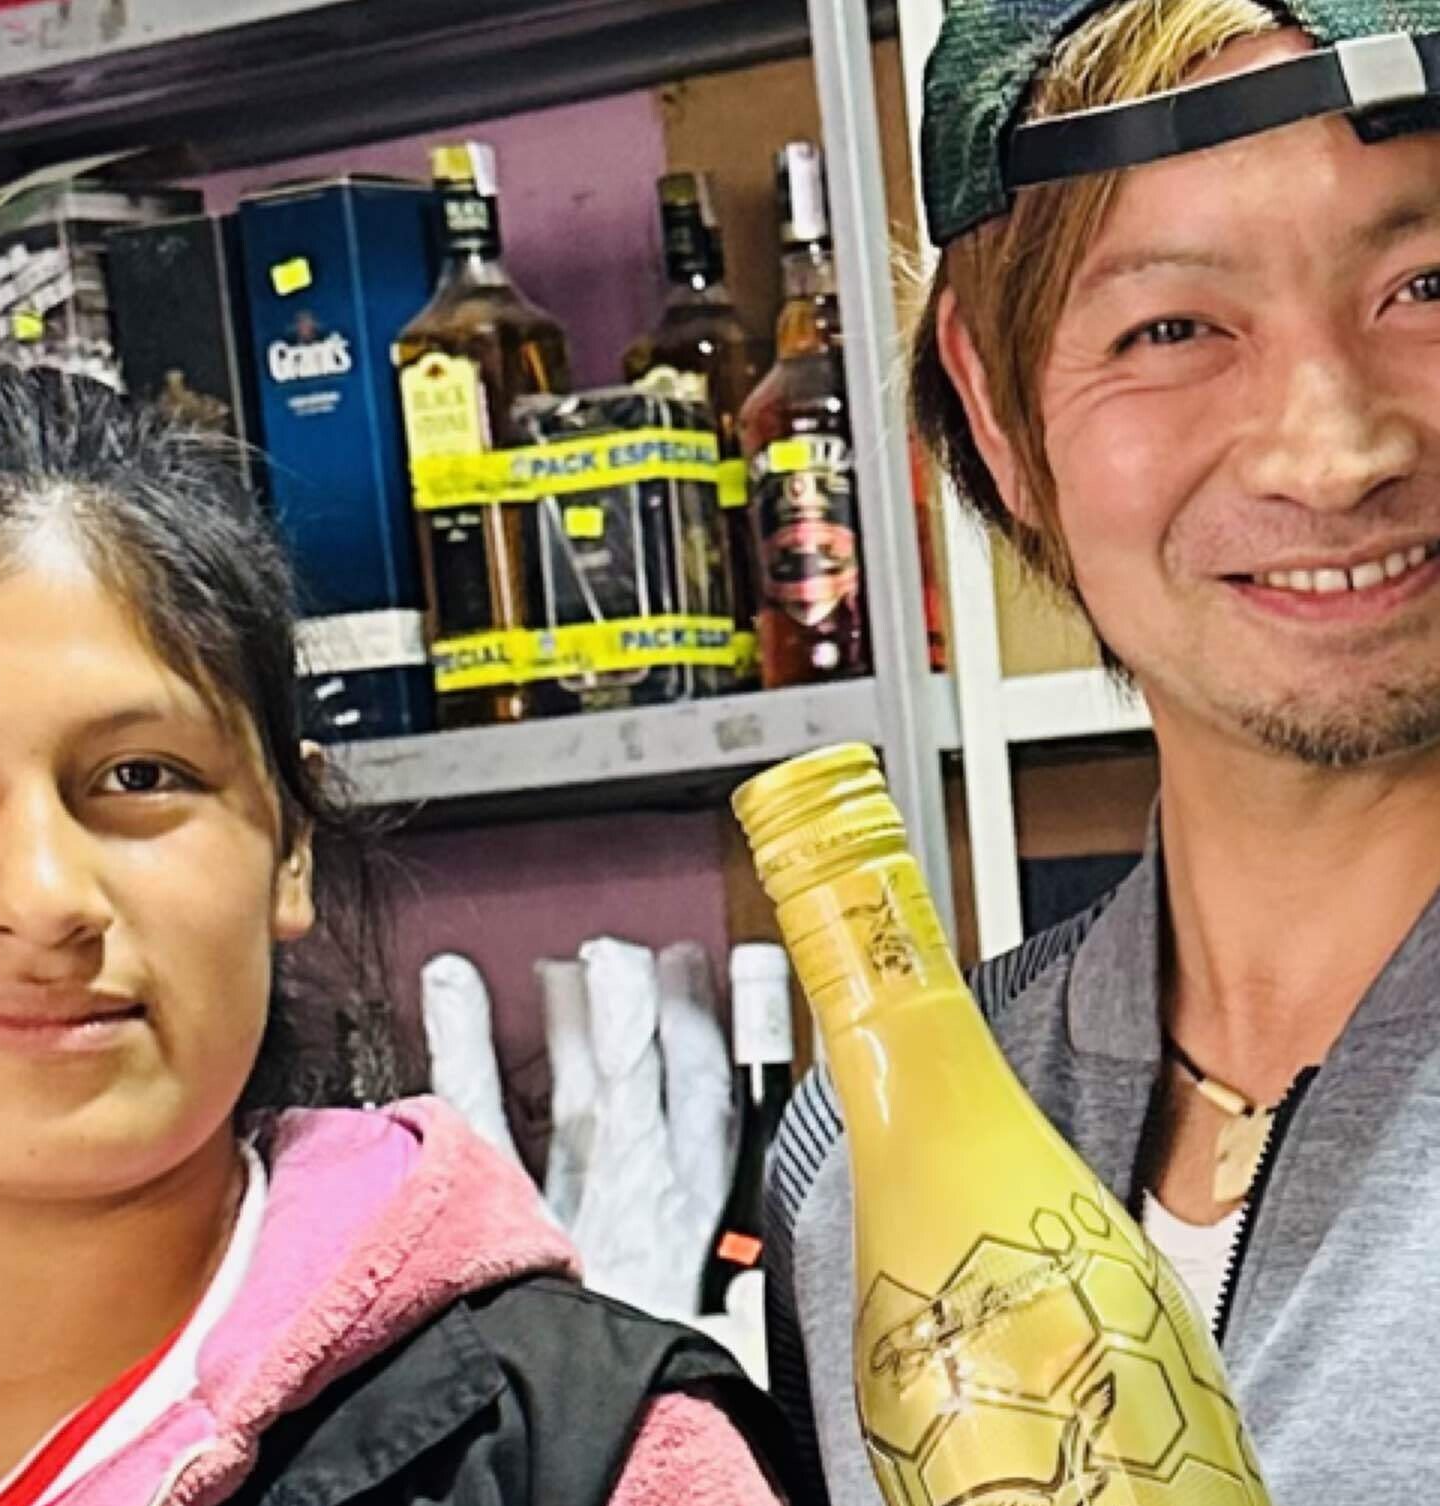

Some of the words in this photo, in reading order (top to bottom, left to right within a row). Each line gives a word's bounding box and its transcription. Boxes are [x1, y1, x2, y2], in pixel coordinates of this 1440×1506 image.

[269, 332, 353, 385] Grant's
[531, 452, 597, 480] PACK
[607, 438, 719, 468] ESPECIAL
